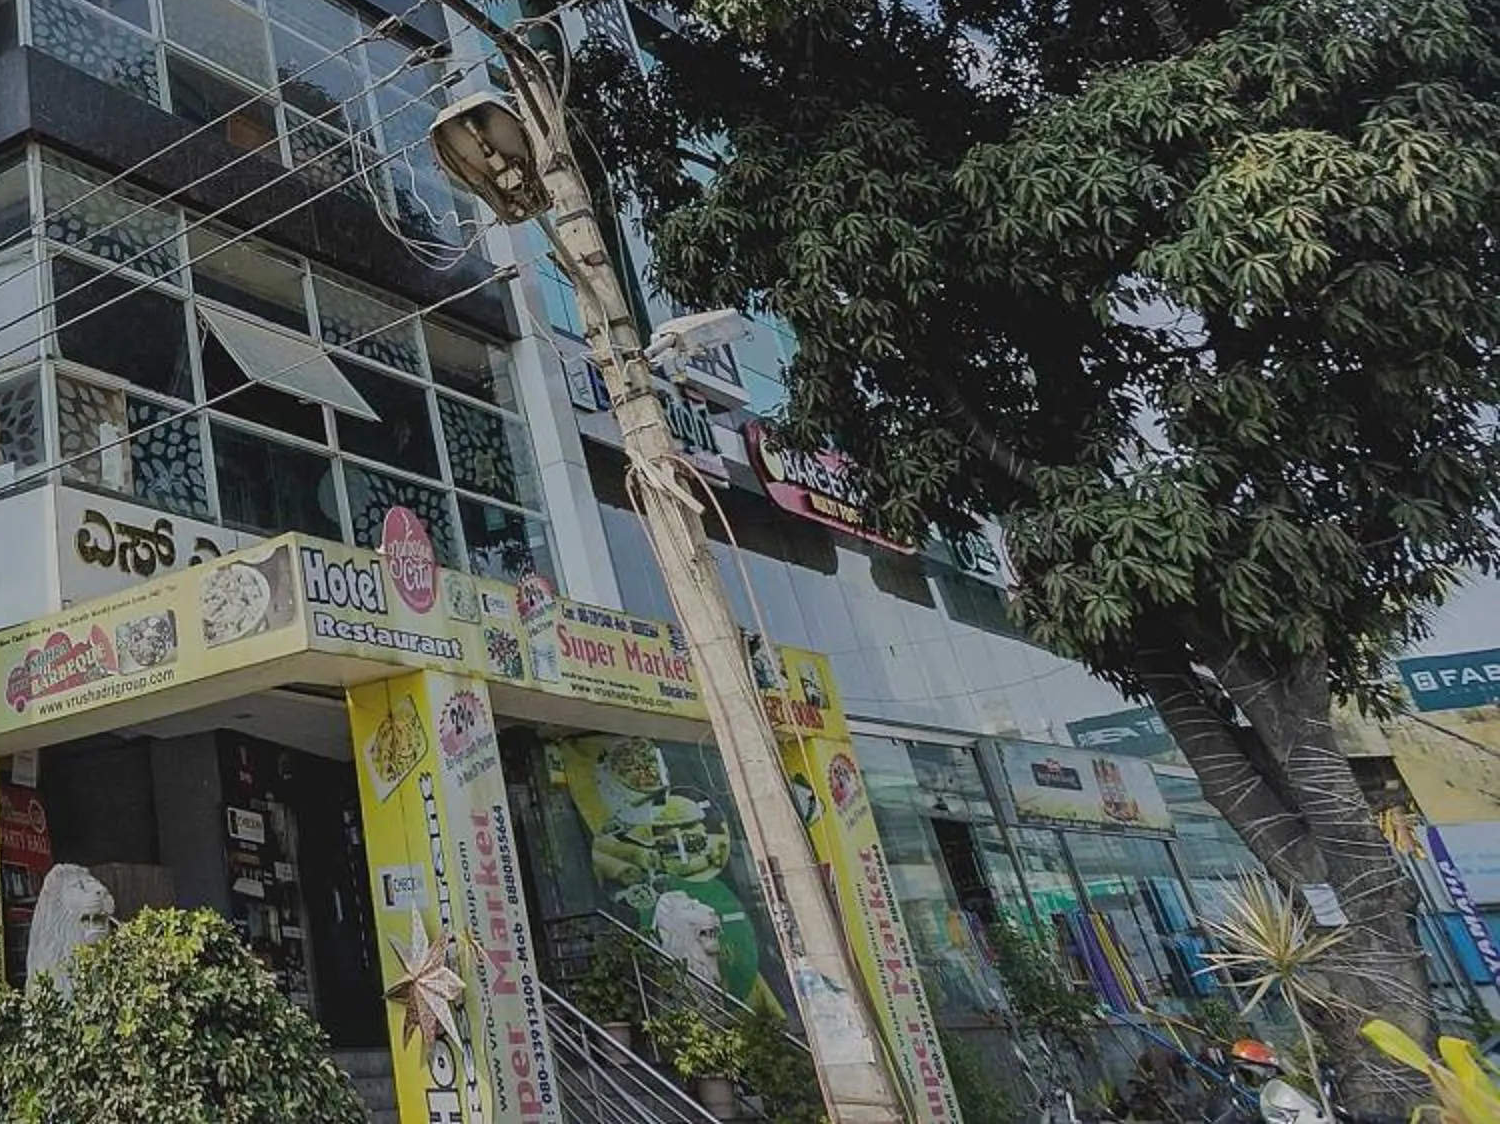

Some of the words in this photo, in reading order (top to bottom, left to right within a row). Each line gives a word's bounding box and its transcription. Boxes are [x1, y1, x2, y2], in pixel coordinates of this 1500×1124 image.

[301, 548, 389, 615] Hotel
[314, 611, 463, 661] Restaurant
[557, 623, 617, 669] Super
[623, 639, 694, 683] Market
[31, 641, 107, 695] BARBEQUE
[469, 808, 517, 996] Market
[521, 974, 553, 1105] 080-33913400
